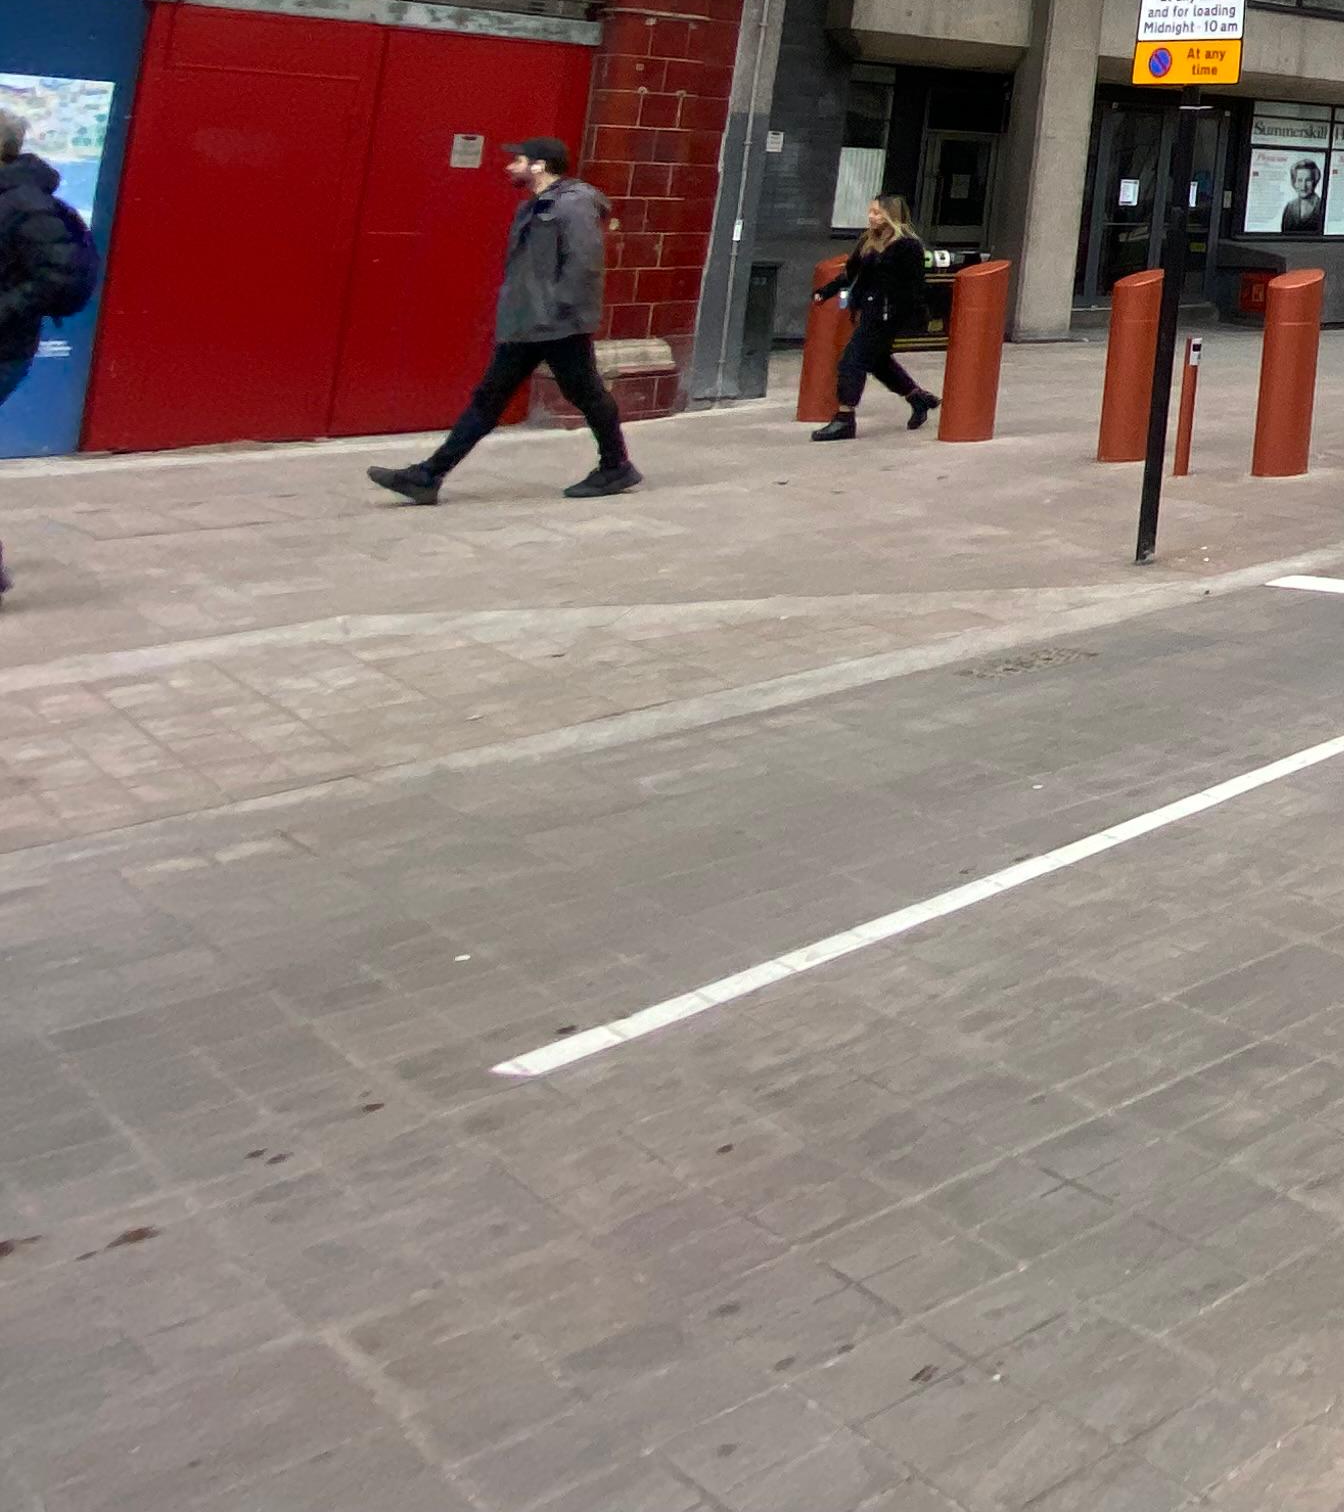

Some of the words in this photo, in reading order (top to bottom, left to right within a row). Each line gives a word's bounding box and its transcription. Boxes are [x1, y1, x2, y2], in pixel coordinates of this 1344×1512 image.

[1148, 6, 1168, 18] and
[1173, 5, 1189, 17] for
[1193, 4, 1236, 18] loading
[1143, 21, 1195, 35] Midnight
[1204, 20, 1218, 32] 10
[1220, 22, 1238, 32] am
[1186, 47, 1200, 59] At
[1205, 49, 1226, 61] any
[1192, 64, 1218, 75] time
[1253, 121, 1328, 140] Summerskill
